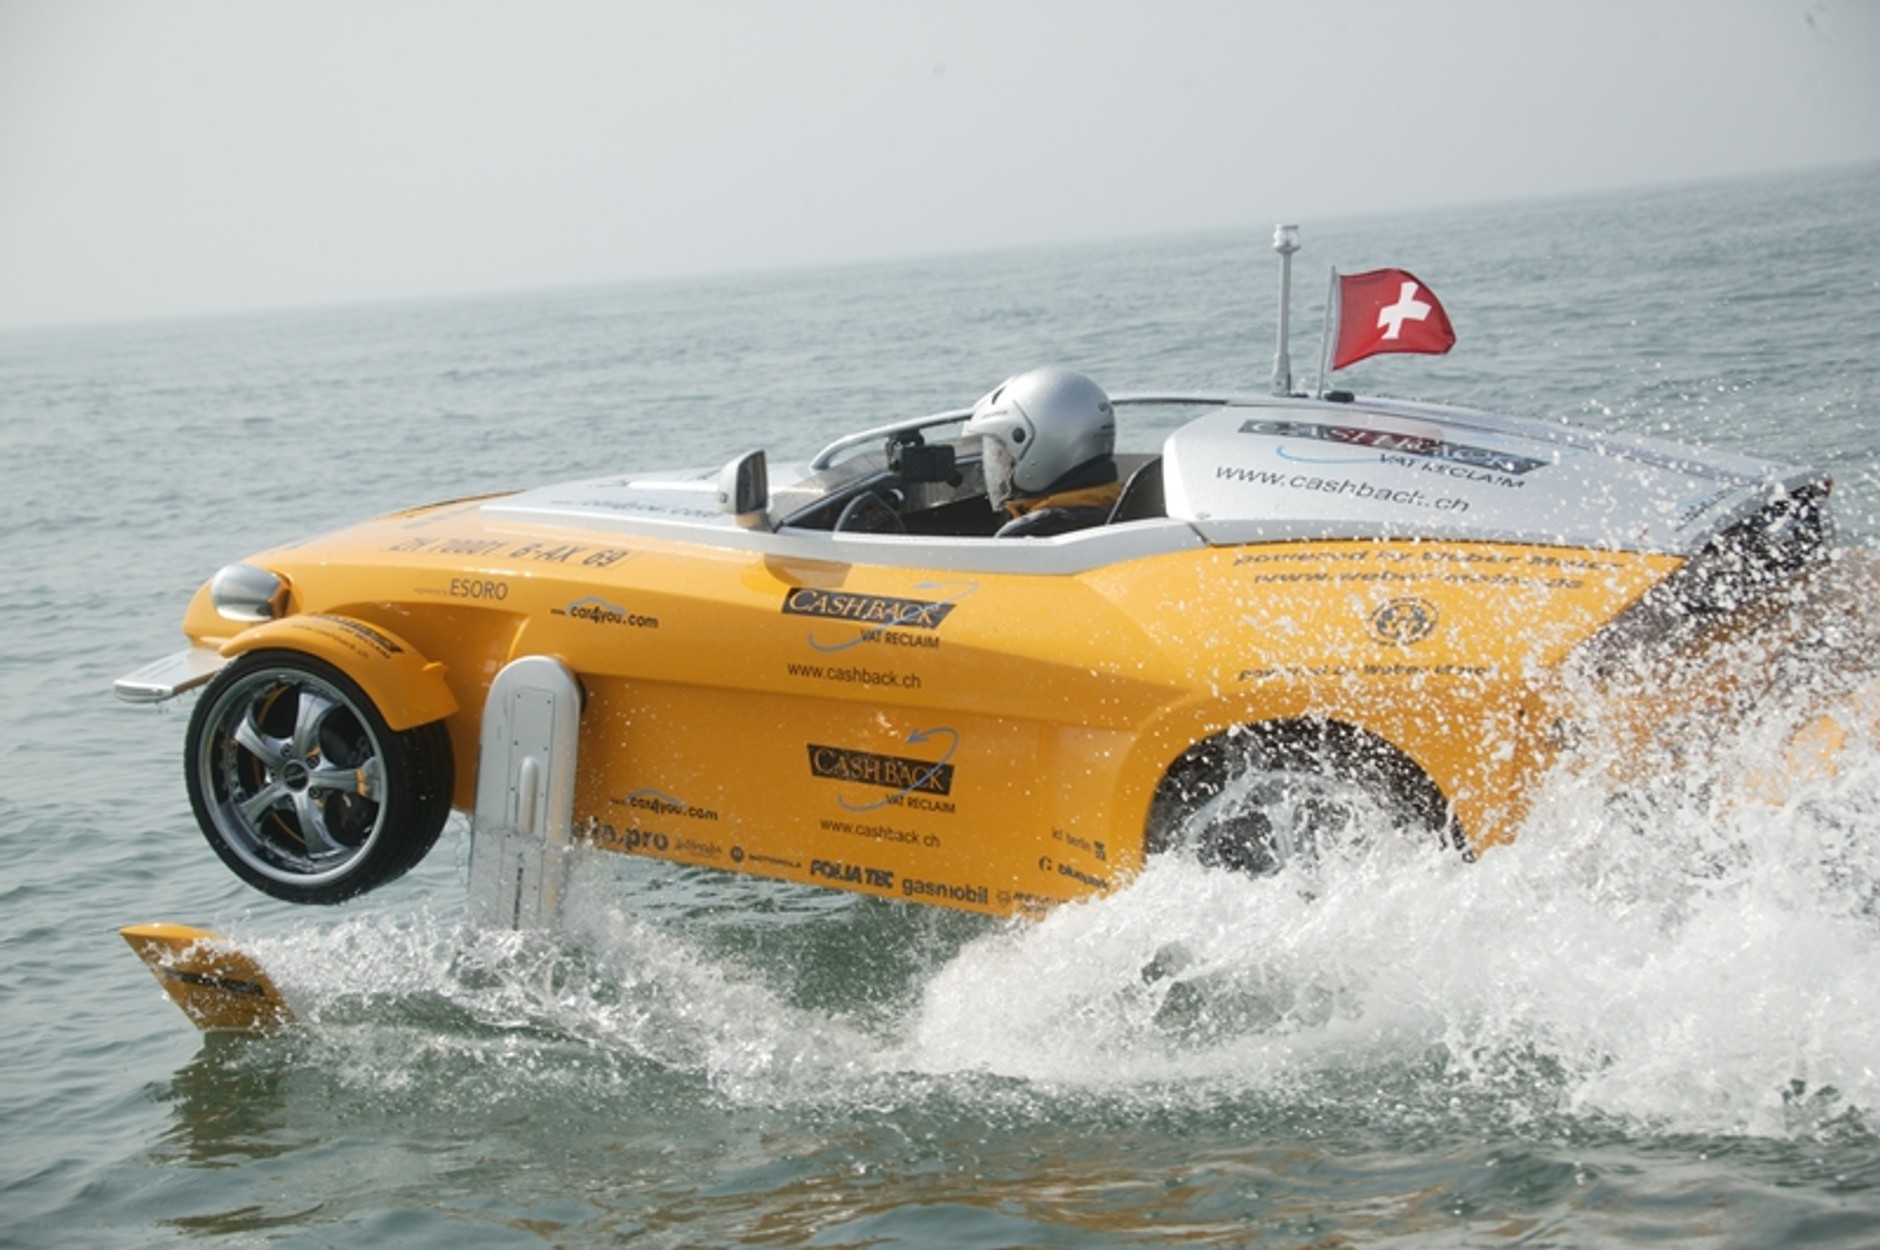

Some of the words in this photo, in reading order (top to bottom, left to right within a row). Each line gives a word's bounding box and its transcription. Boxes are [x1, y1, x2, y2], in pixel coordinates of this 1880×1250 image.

[1379, 453, 1415, 467] VAT
[1423, 457, 1526, 488] RECLAIM
[1216, 466, 1471, 512] www.cashback.ch
[450, 578, 509, 601] ESORO
[885, 632, 940, 648] RECLAIM
[787, 663, 922, 689] www.cashback.ch
[907, 797, 956, 814] RECLAIM
[902, 878, 989, 905] gasmobil
